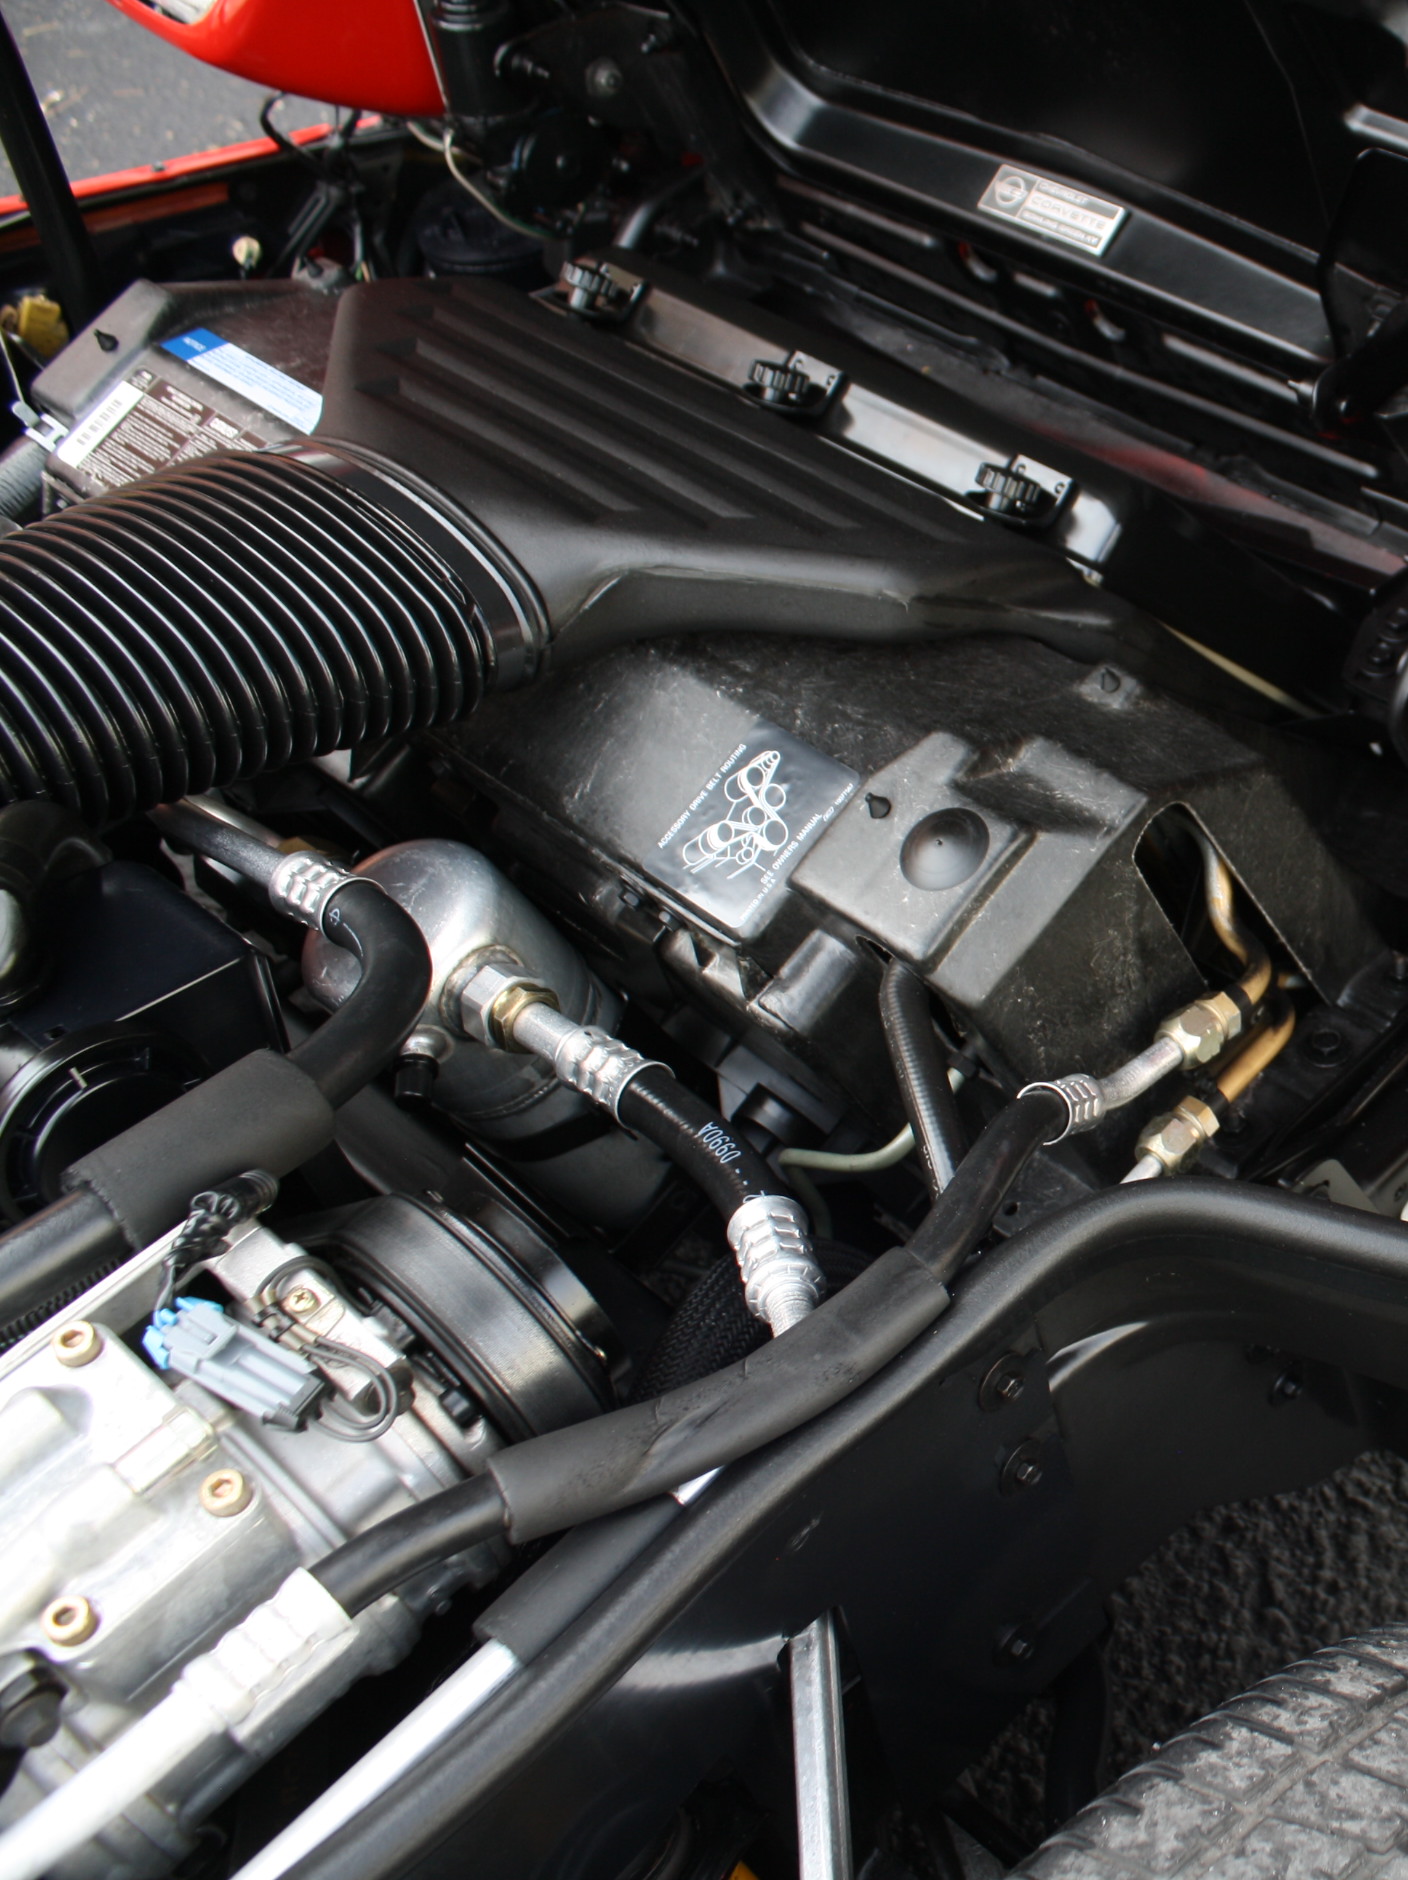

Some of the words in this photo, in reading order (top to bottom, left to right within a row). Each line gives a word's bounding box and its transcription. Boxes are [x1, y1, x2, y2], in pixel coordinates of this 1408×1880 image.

[1031, 196, 1106, 230] CORVETTE
[657, 809, 691, 849] ACCESSORY
[688, 790, 708, 811] DRIVE
[705, 772, 722, 791] BELT
[720, 743, 747, 773] ROUTING
[760, 870, 775, 885] SEE
[772, 840, 799, 870] OWNERS
[796, 813, 823, 841] MANUAL
